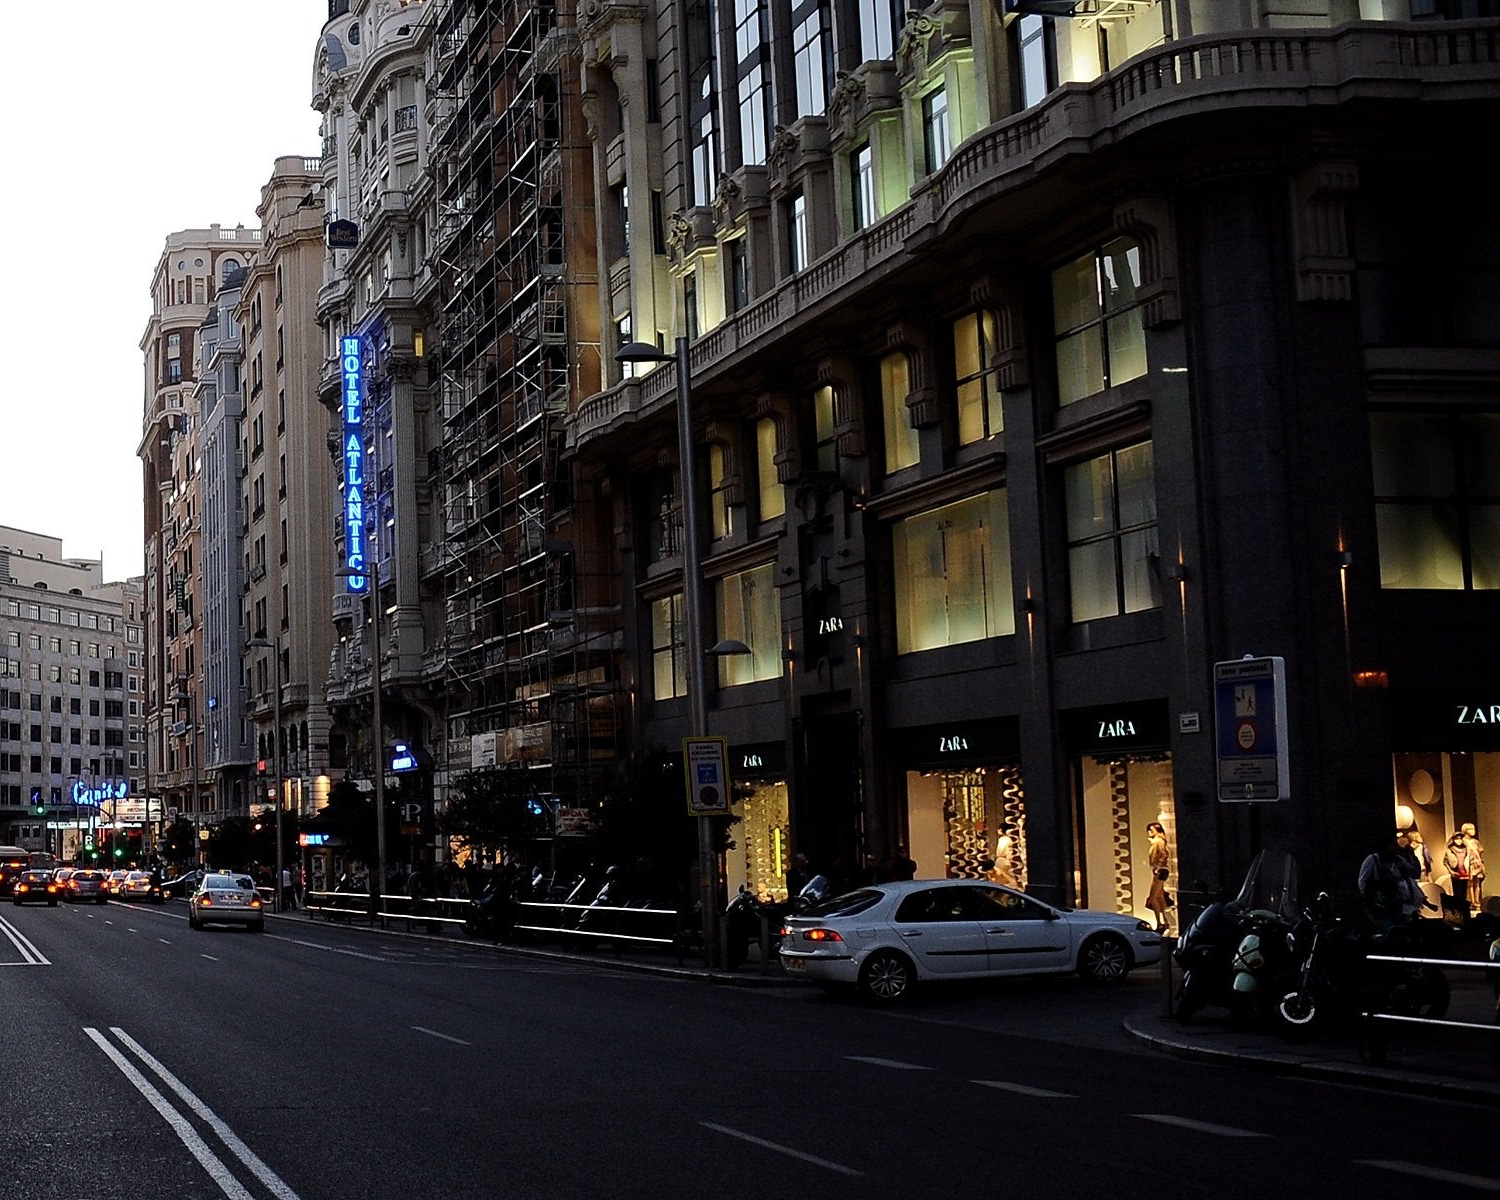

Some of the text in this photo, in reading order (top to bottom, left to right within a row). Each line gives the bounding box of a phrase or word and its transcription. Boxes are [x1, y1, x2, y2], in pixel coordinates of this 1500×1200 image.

[344, 338, 360, 424] HOTEL
[346, 433, 365, 589] ATLANTICO
[819, 616, 844, 635] ZARA
[1097, 719, 1137, 738] ZARA
[939, 735, 969, 752] ZARA
[743, 754, 763, 768] ZARA
